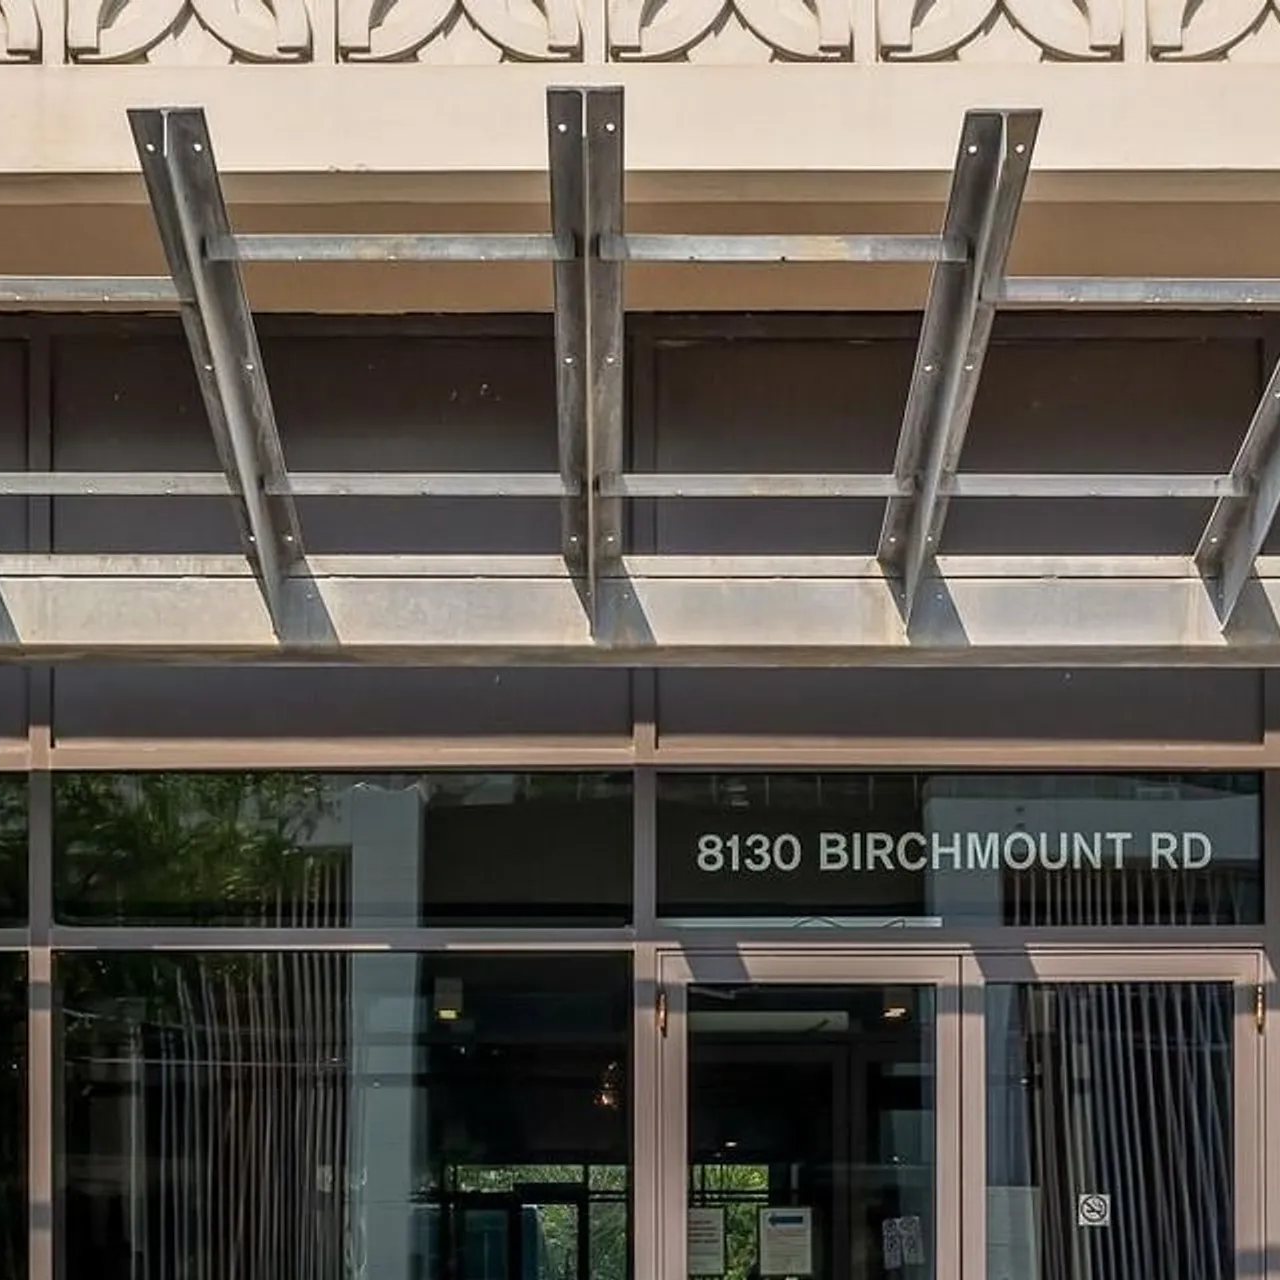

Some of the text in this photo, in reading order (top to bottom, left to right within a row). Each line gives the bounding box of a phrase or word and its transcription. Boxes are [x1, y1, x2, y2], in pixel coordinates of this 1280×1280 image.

[697, 831, 1212, 872] 8130 BIRCHMOUNT RD
